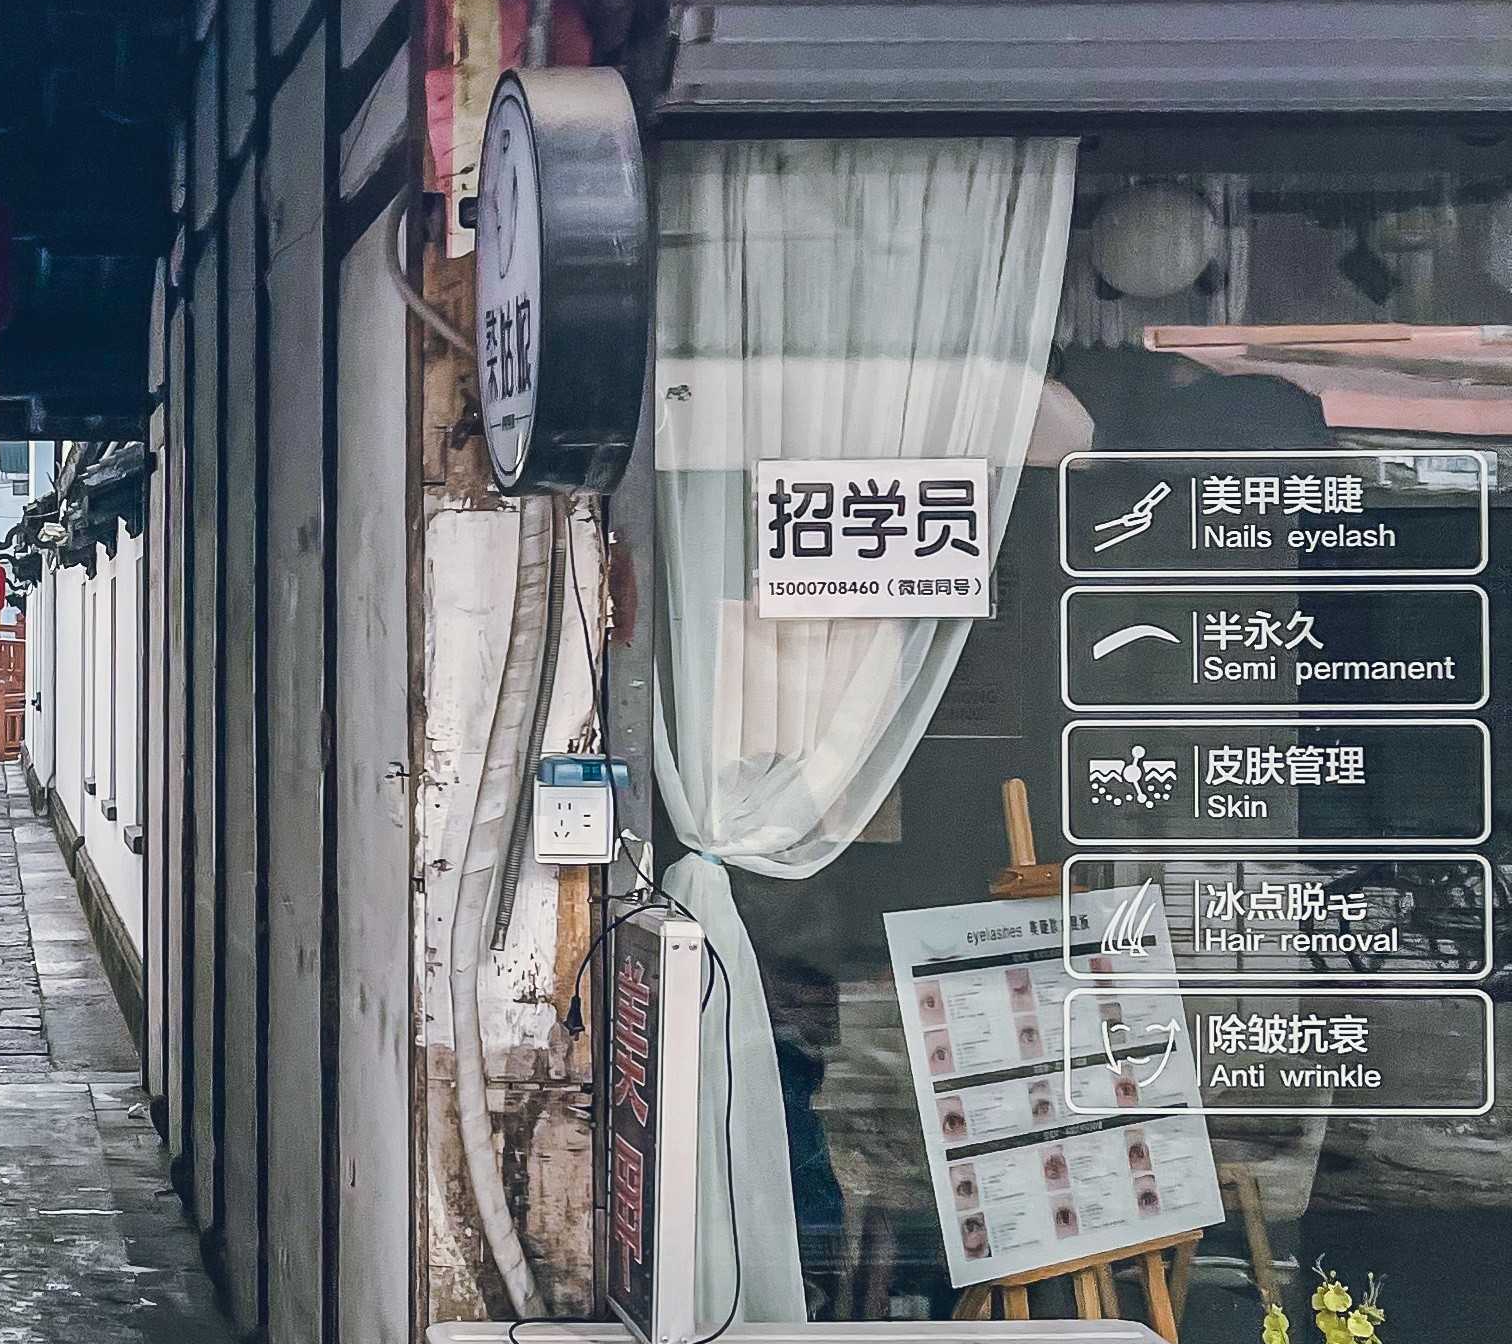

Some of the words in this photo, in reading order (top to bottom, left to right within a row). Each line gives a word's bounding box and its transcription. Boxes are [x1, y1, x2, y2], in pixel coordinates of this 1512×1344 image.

[1202, 474, 1364, 515] 美甲美睫
[768, 478, 980, 559] 招学员
[1203, 524, 1273, 548] Nails
[1287, 523, 1396, 553] eyelash
[1203, 610, 1324, 651] 半永久
[1203, 656, 1277, 681] Semi
[1295, 656, 1456, 686] permanent
[1204, 744, 1366, 786] 皮肤管理
[1207, 794, 1268, 819] Skin
[1205, 881, 1368, 921] 冰点脱毛
[1205, 928, 1265, 953] Hair
[1280, 927, 1399, 953] removal
[1208, 1013, 1369, 1055] 除皱抗衰
[1208, 1064, 1265, 1088] Anti
[1279, 1063, 1383, 1088] wrinkle
[614, 954, 651, 1295] 美甲
